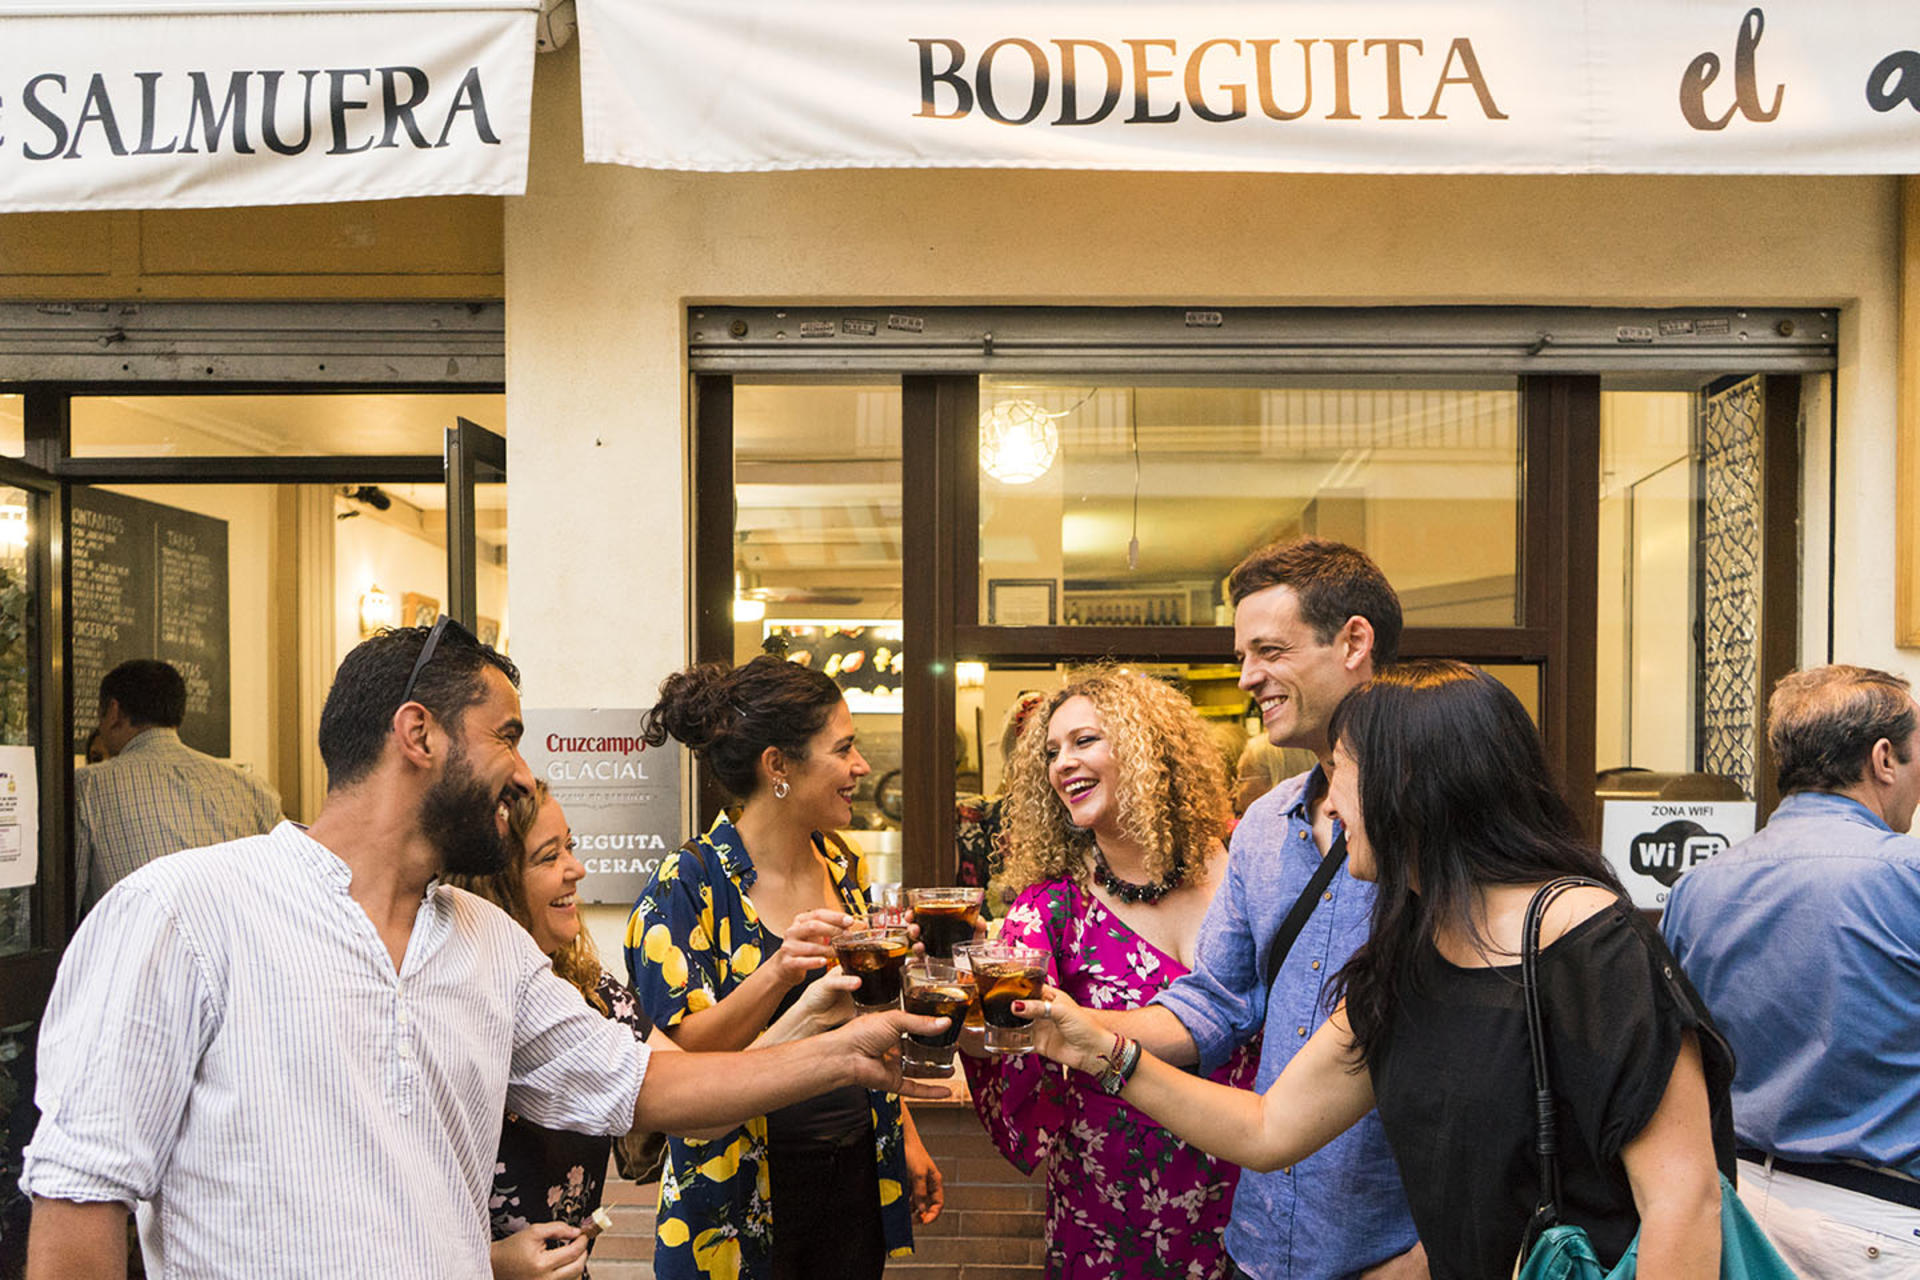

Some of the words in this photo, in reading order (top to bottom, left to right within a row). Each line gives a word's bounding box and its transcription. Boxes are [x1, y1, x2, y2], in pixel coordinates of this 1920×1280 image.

[909, 37, 1509, 126] BODEGUITA
[1679, 7, 1785, 131] el
[23, 66, 501, 161] SALMUERA
[546, 733, 646, 755] Cruzcampo
[547, 761, 649, 781] GLACIAL
[1652, 806, 1685, 816] ZONA
[1689, 806, 1713, 816] WIFI
